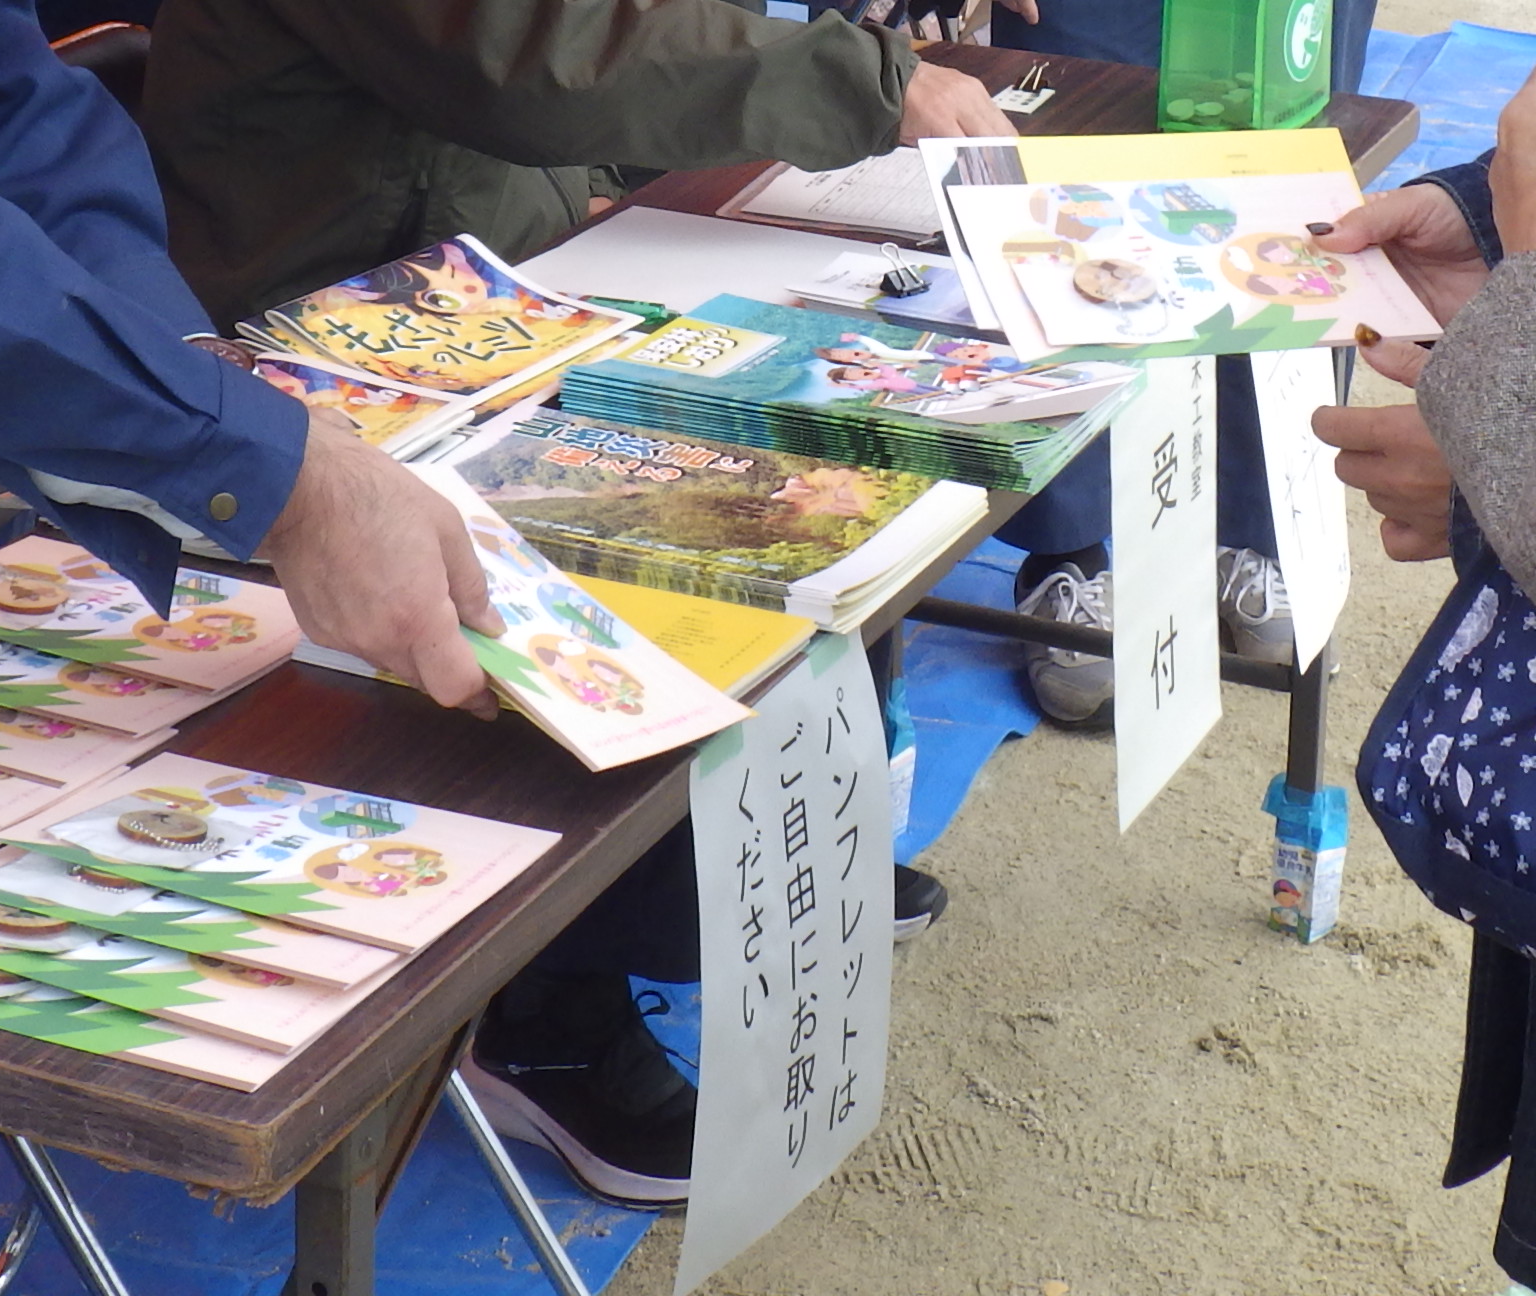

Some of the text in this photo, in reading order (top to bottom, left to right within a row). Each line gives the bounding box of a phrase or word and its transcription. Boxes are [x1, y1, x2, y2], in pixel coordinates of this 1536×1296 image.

[512, 417, 755, 473] 山地災害に
[1150, 432, 1178, 710] 受付
[735, 767, 770, 1030] ください
[779, 721, 817, 1169] ご自由にお取り
[825, 686, 863, 1132] パンフレットは
